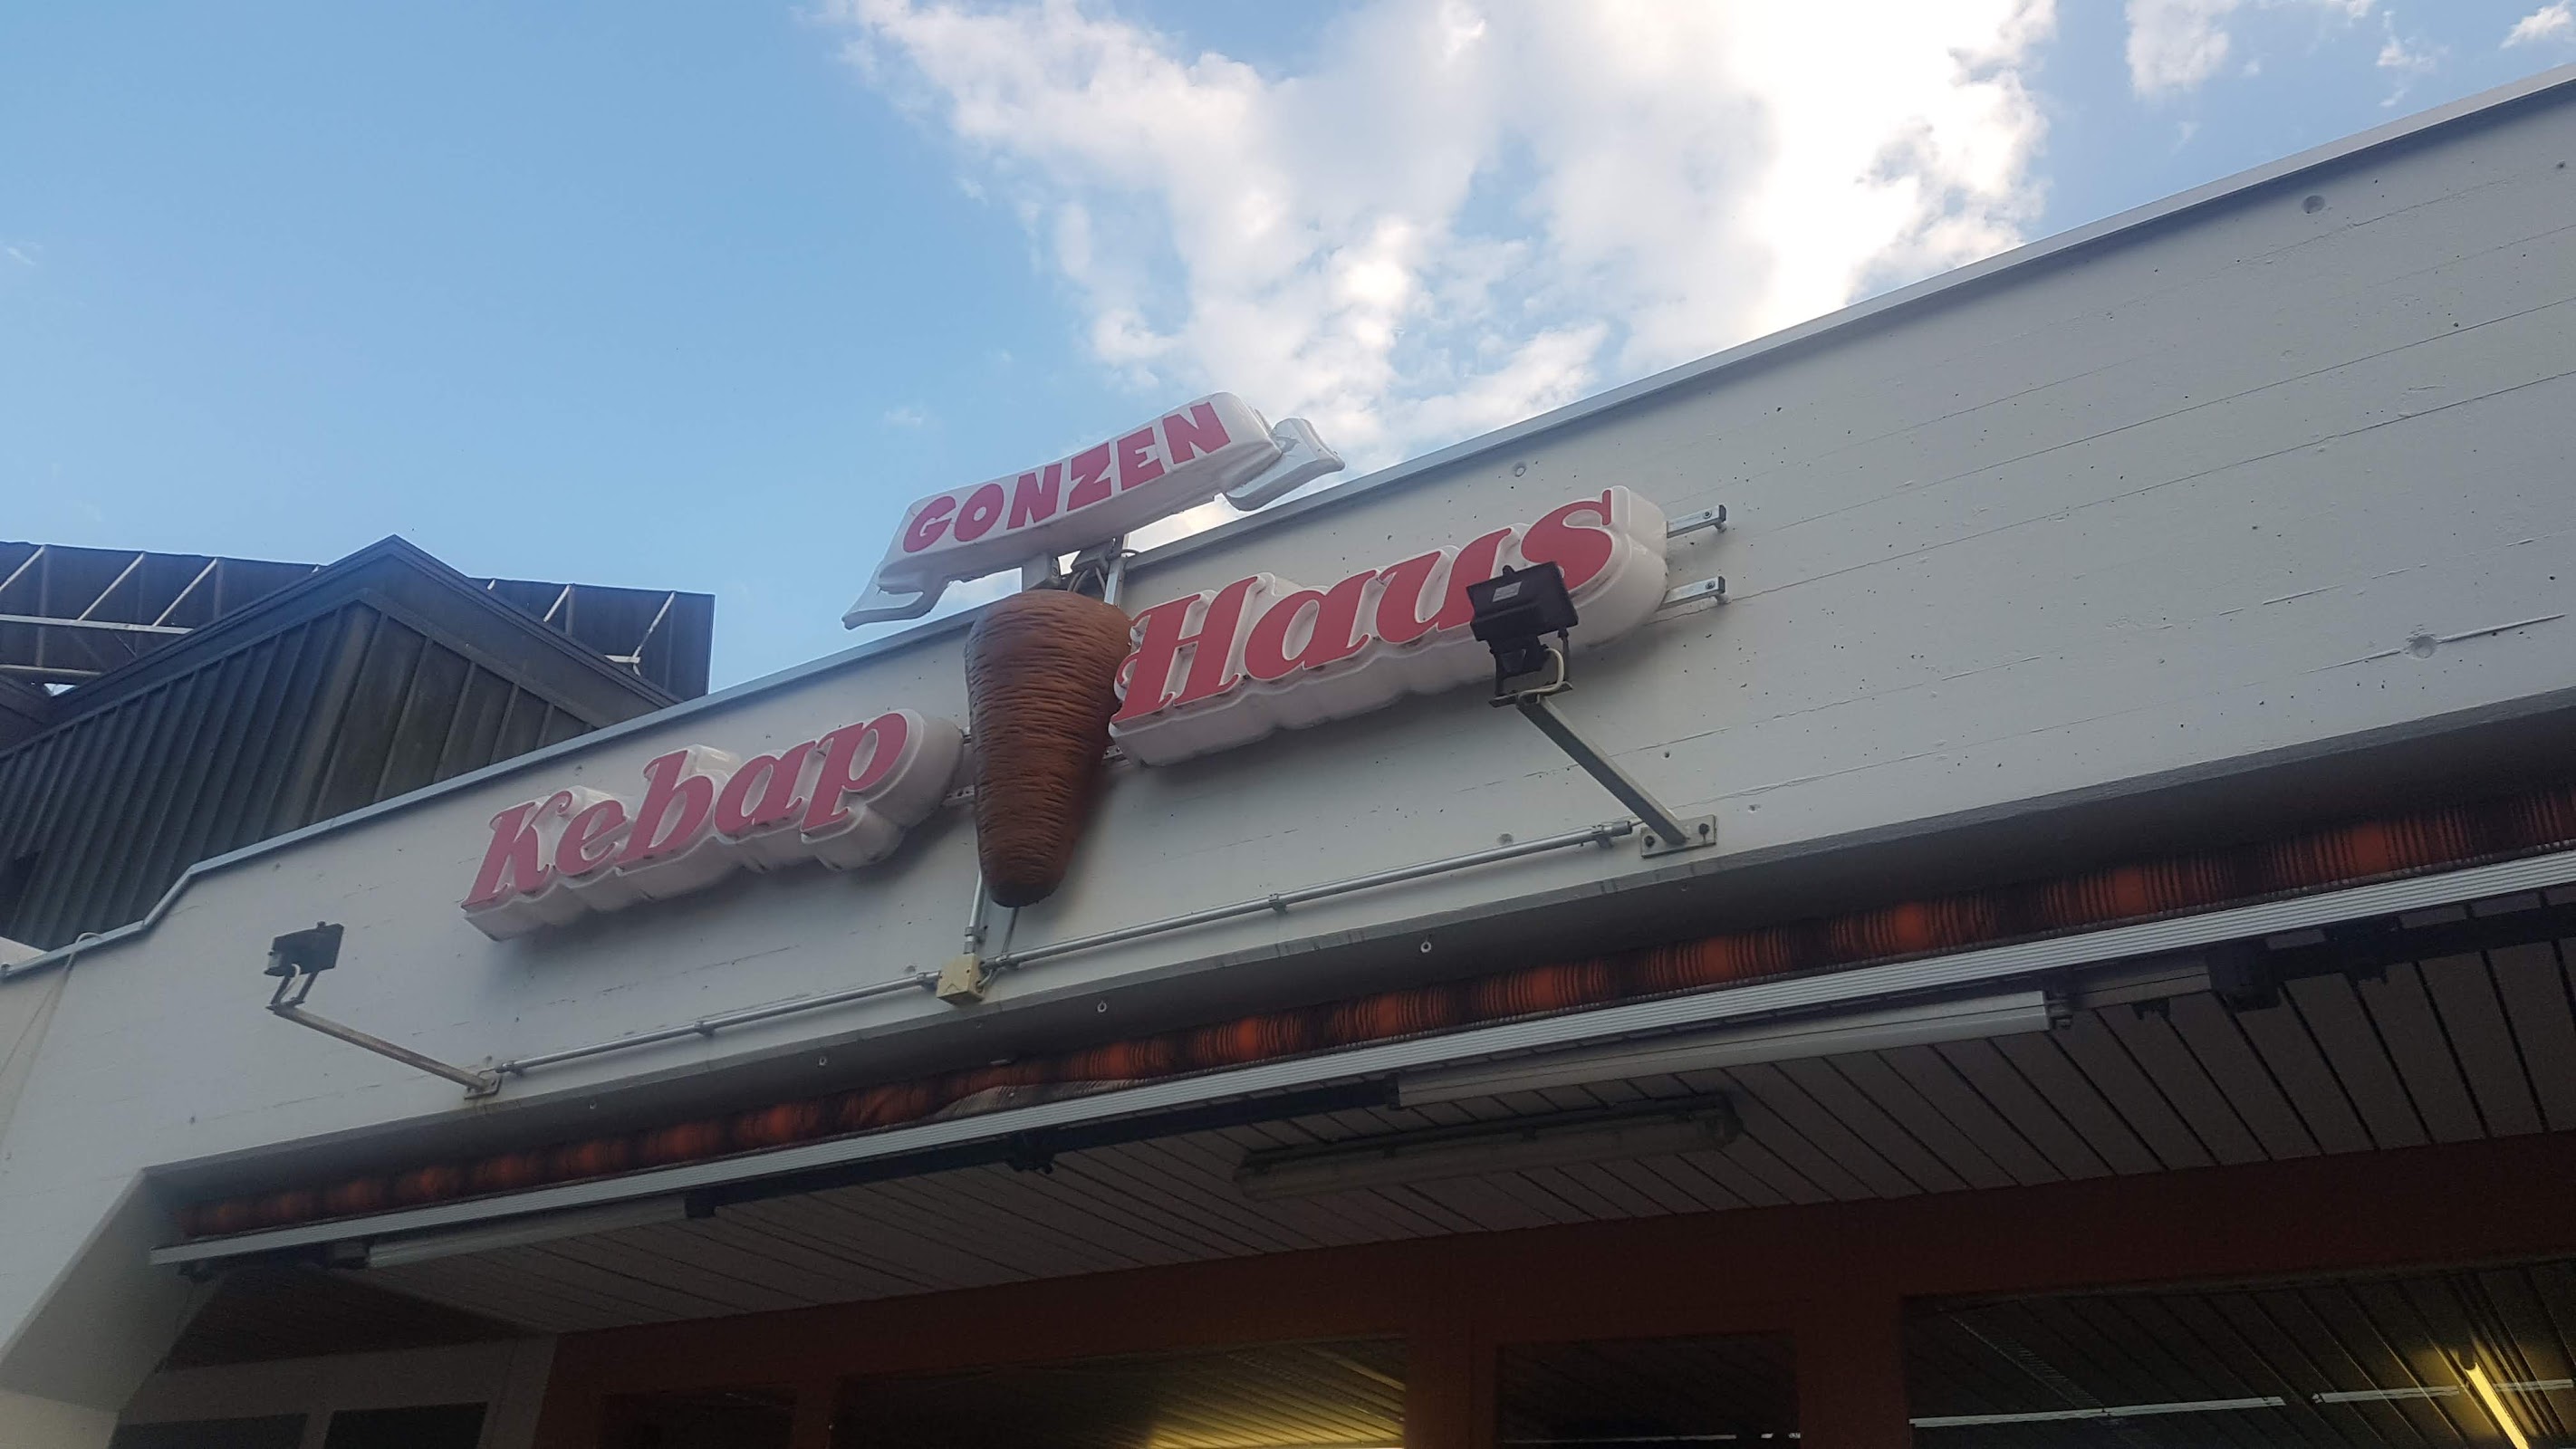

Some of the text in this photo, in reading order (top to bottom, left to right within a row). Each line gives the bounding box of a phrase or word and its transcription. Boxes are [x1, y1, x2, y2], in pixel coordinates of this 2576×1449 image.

[902, 401, 1231, 552] GONZEN
[461, 489, 1612, 908] Kebap Haus
